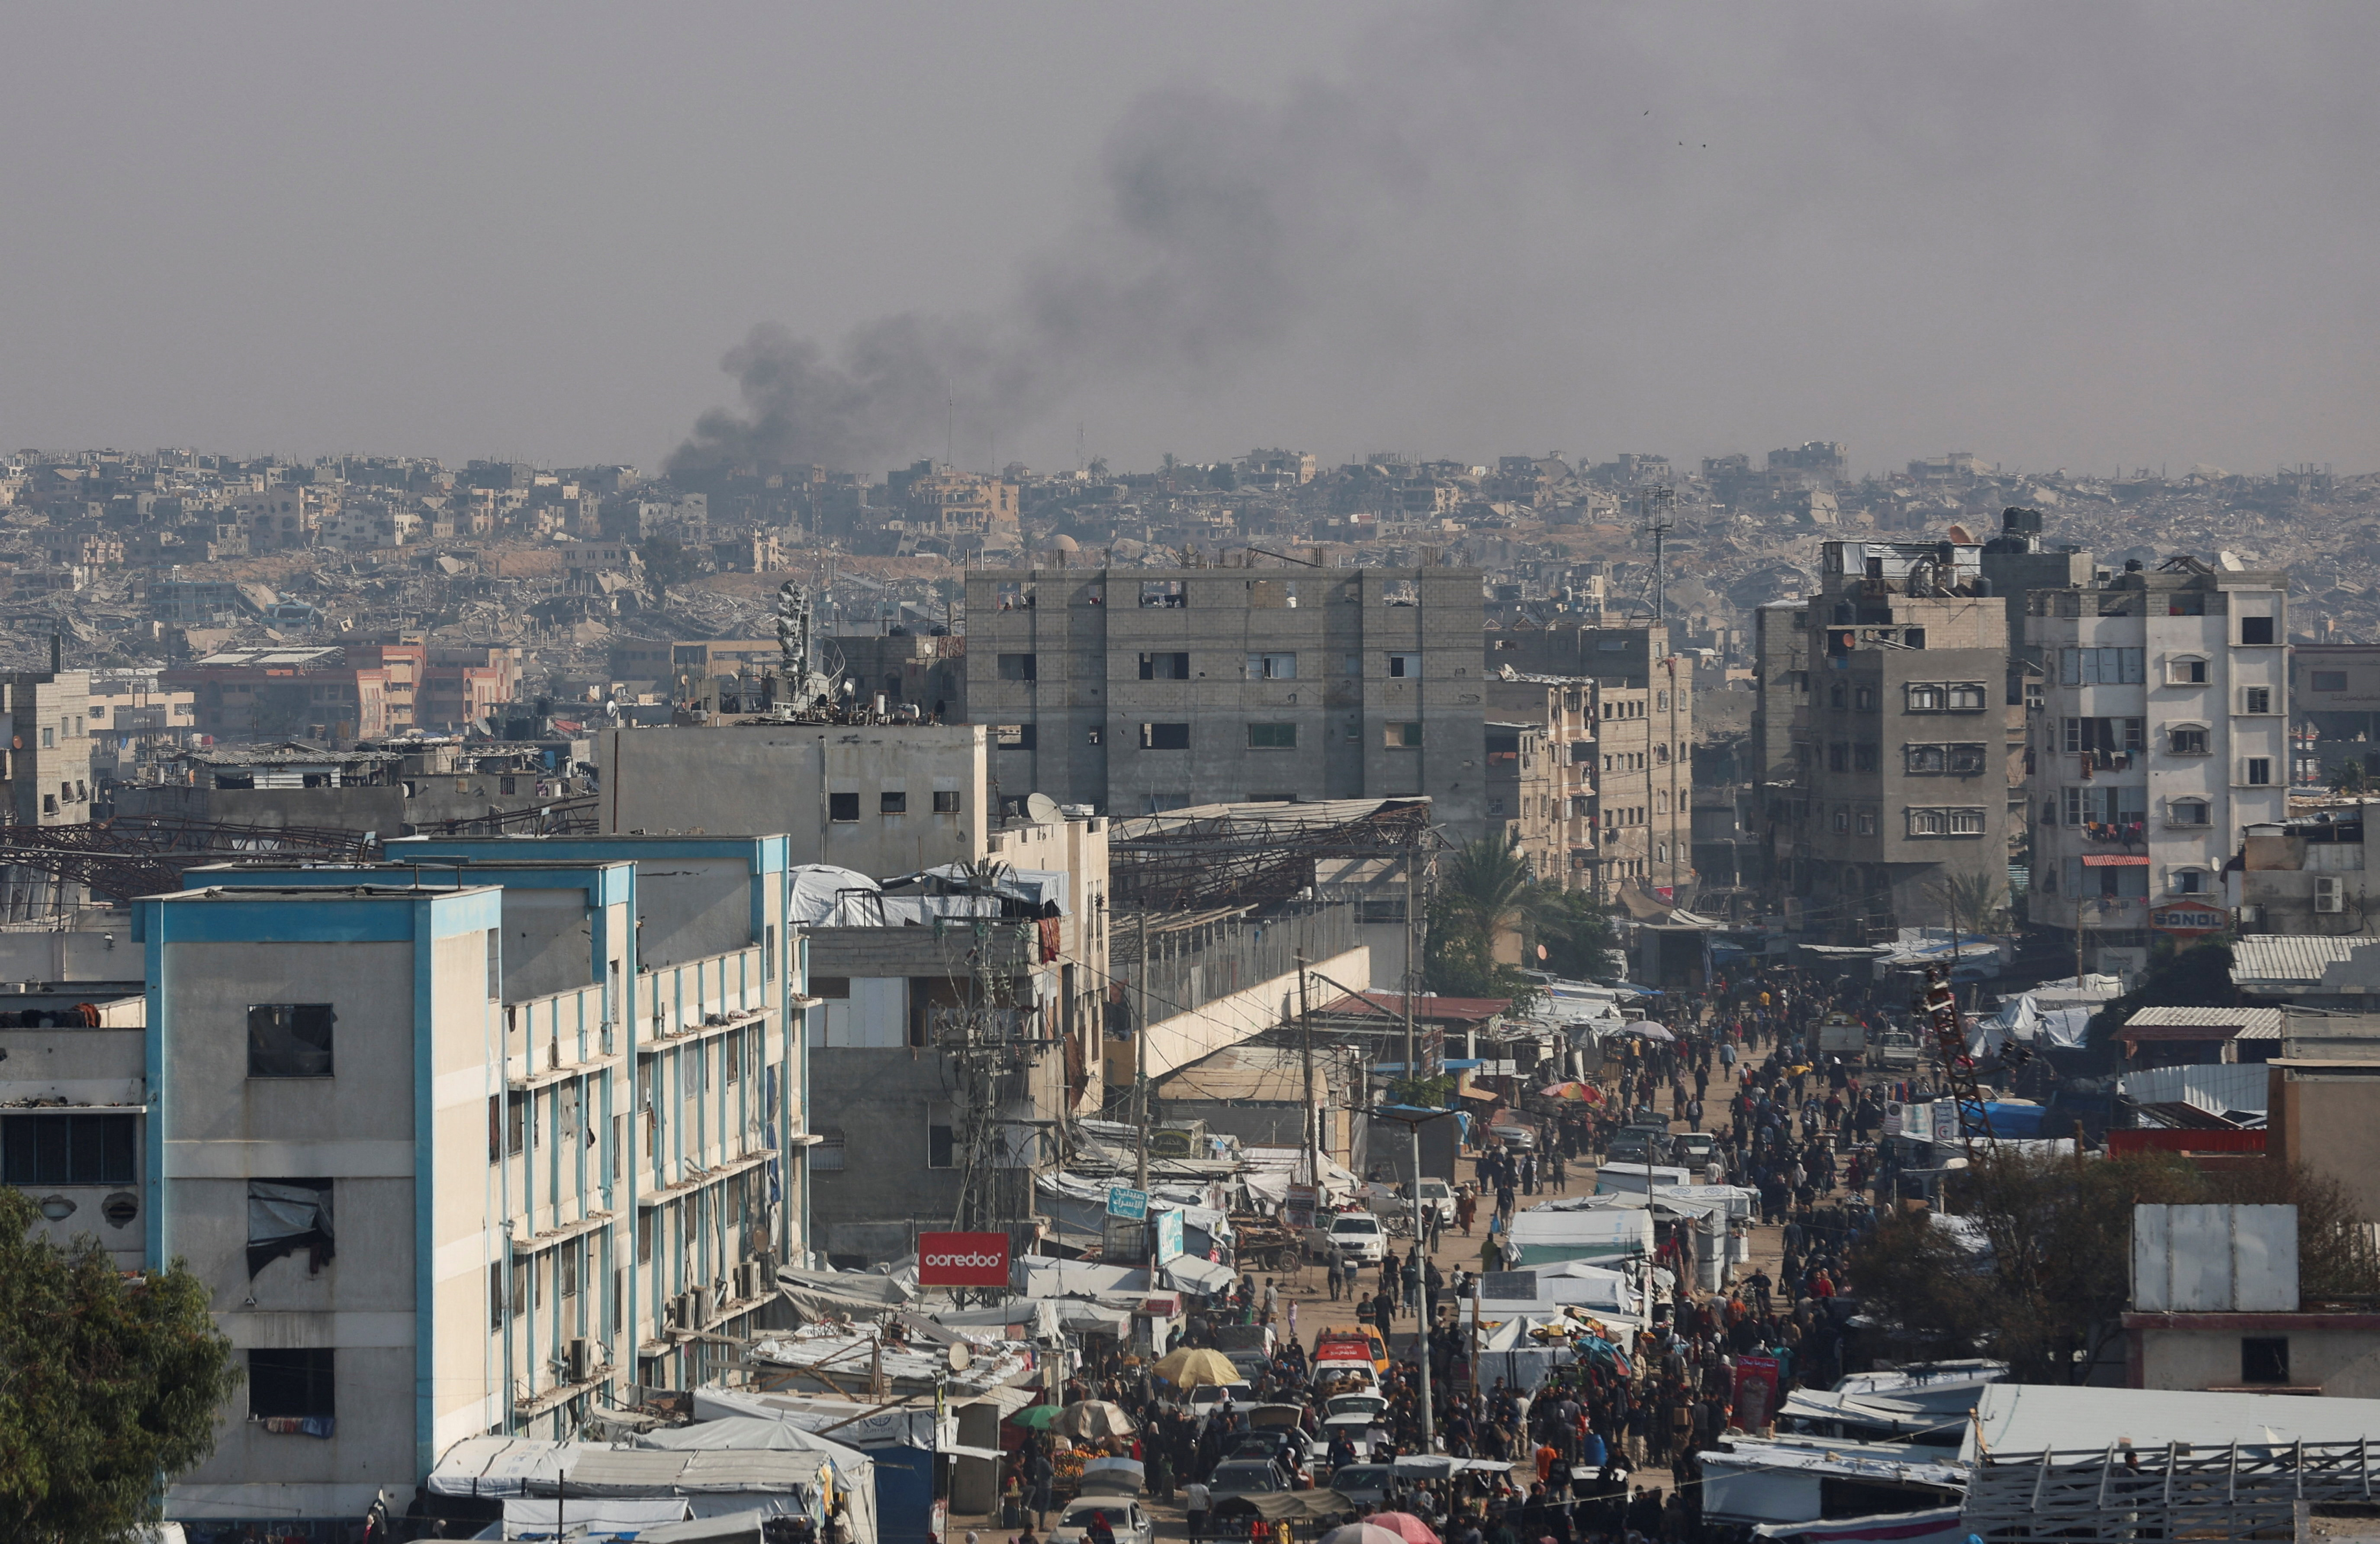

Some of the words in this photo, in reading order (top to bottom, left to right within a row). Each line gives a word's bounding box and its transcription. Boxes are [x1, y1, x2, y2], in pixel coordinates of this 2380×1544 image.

[2155, 913, 2222, 926] SONOL
[1115, 1189, 1144, 1200] صيدلية
[1113, 1198, 1143, 1210] الإسراء
[926, 1251, 999, 1267] ooredoo
